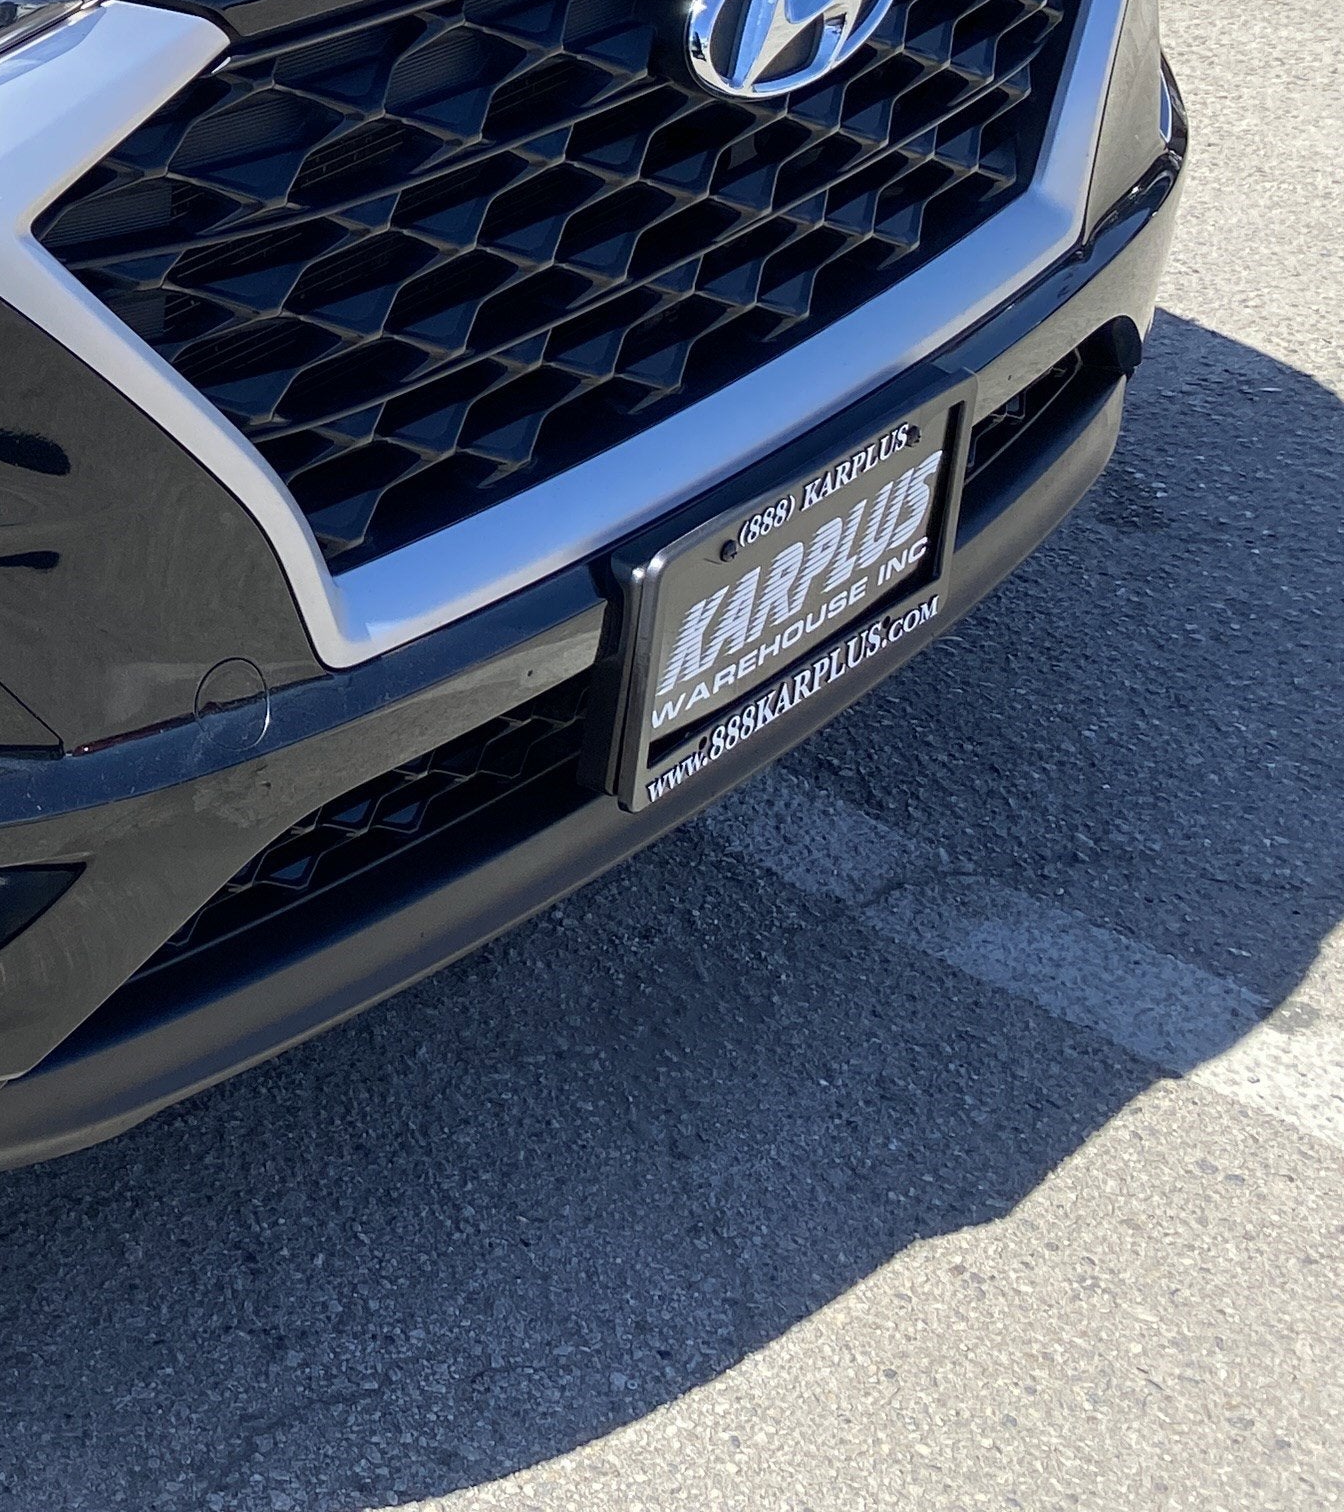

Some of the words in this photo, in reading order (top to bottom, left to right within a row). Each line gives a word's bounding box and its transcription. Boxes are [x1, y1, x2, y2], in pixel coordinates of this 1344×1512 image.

[657, 450, 943, 696] KARPLUS
[739, 496, 796, 547] (888)
[800, 422, 910, 512] KARPLUS
[651, 576, 868, 729] WAREHOUSE
[877, 536, 928, 586] INC
